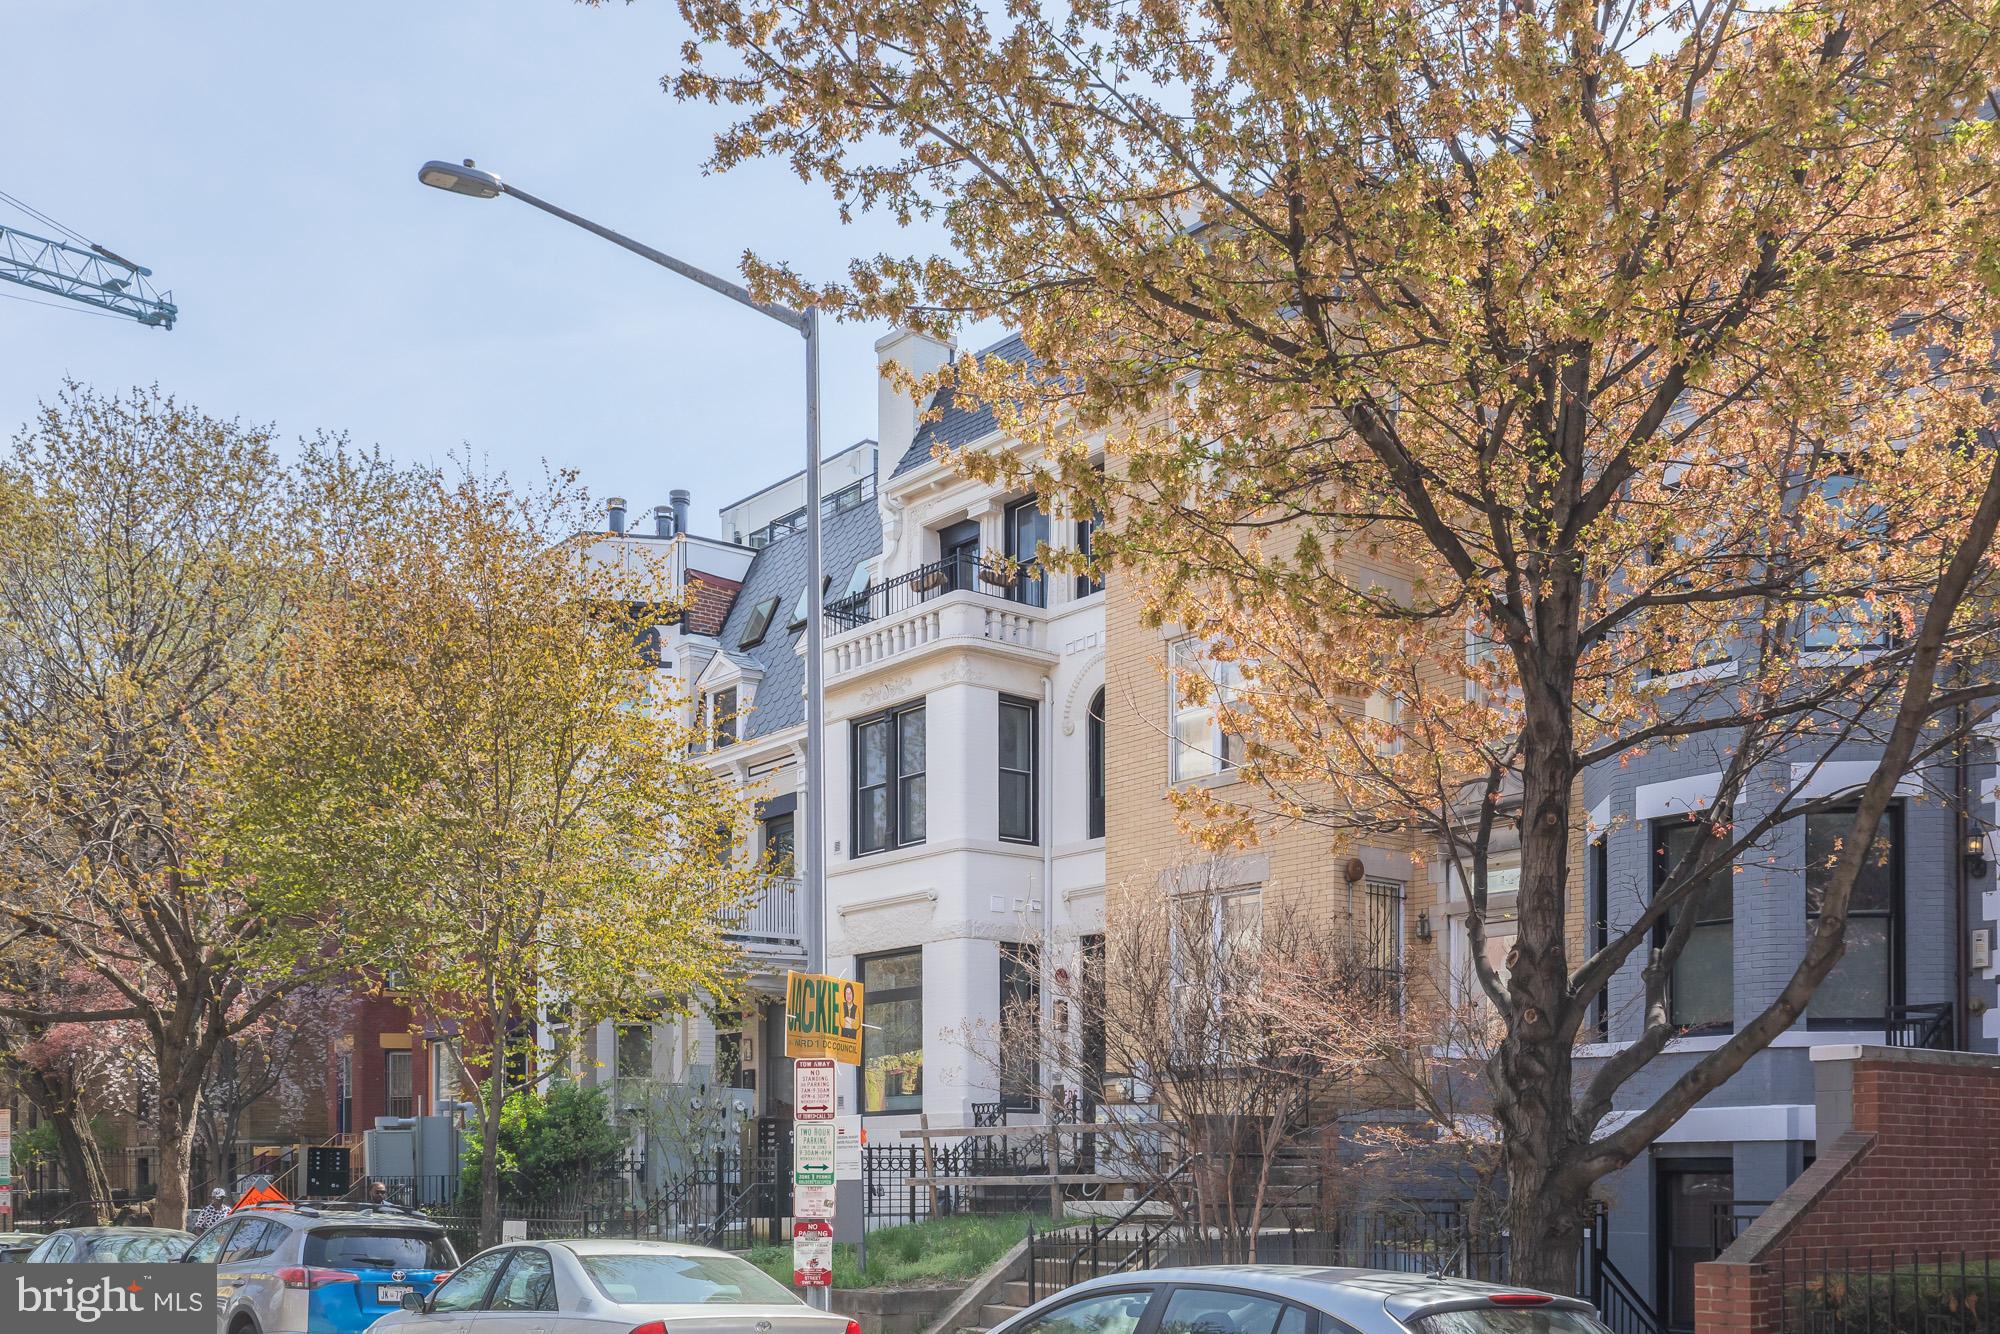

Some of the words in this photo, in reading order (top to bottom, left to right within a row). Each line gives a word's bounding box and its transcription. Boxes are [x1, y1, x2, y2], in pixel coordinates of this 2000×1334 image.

[788, 977, 839, 1035] JACKIE
[833, 1042, 857, 1054] COUNCIL
[800, 1128, 812, 1136] TWO
[814, 1128, 831, 1136] HOUR
